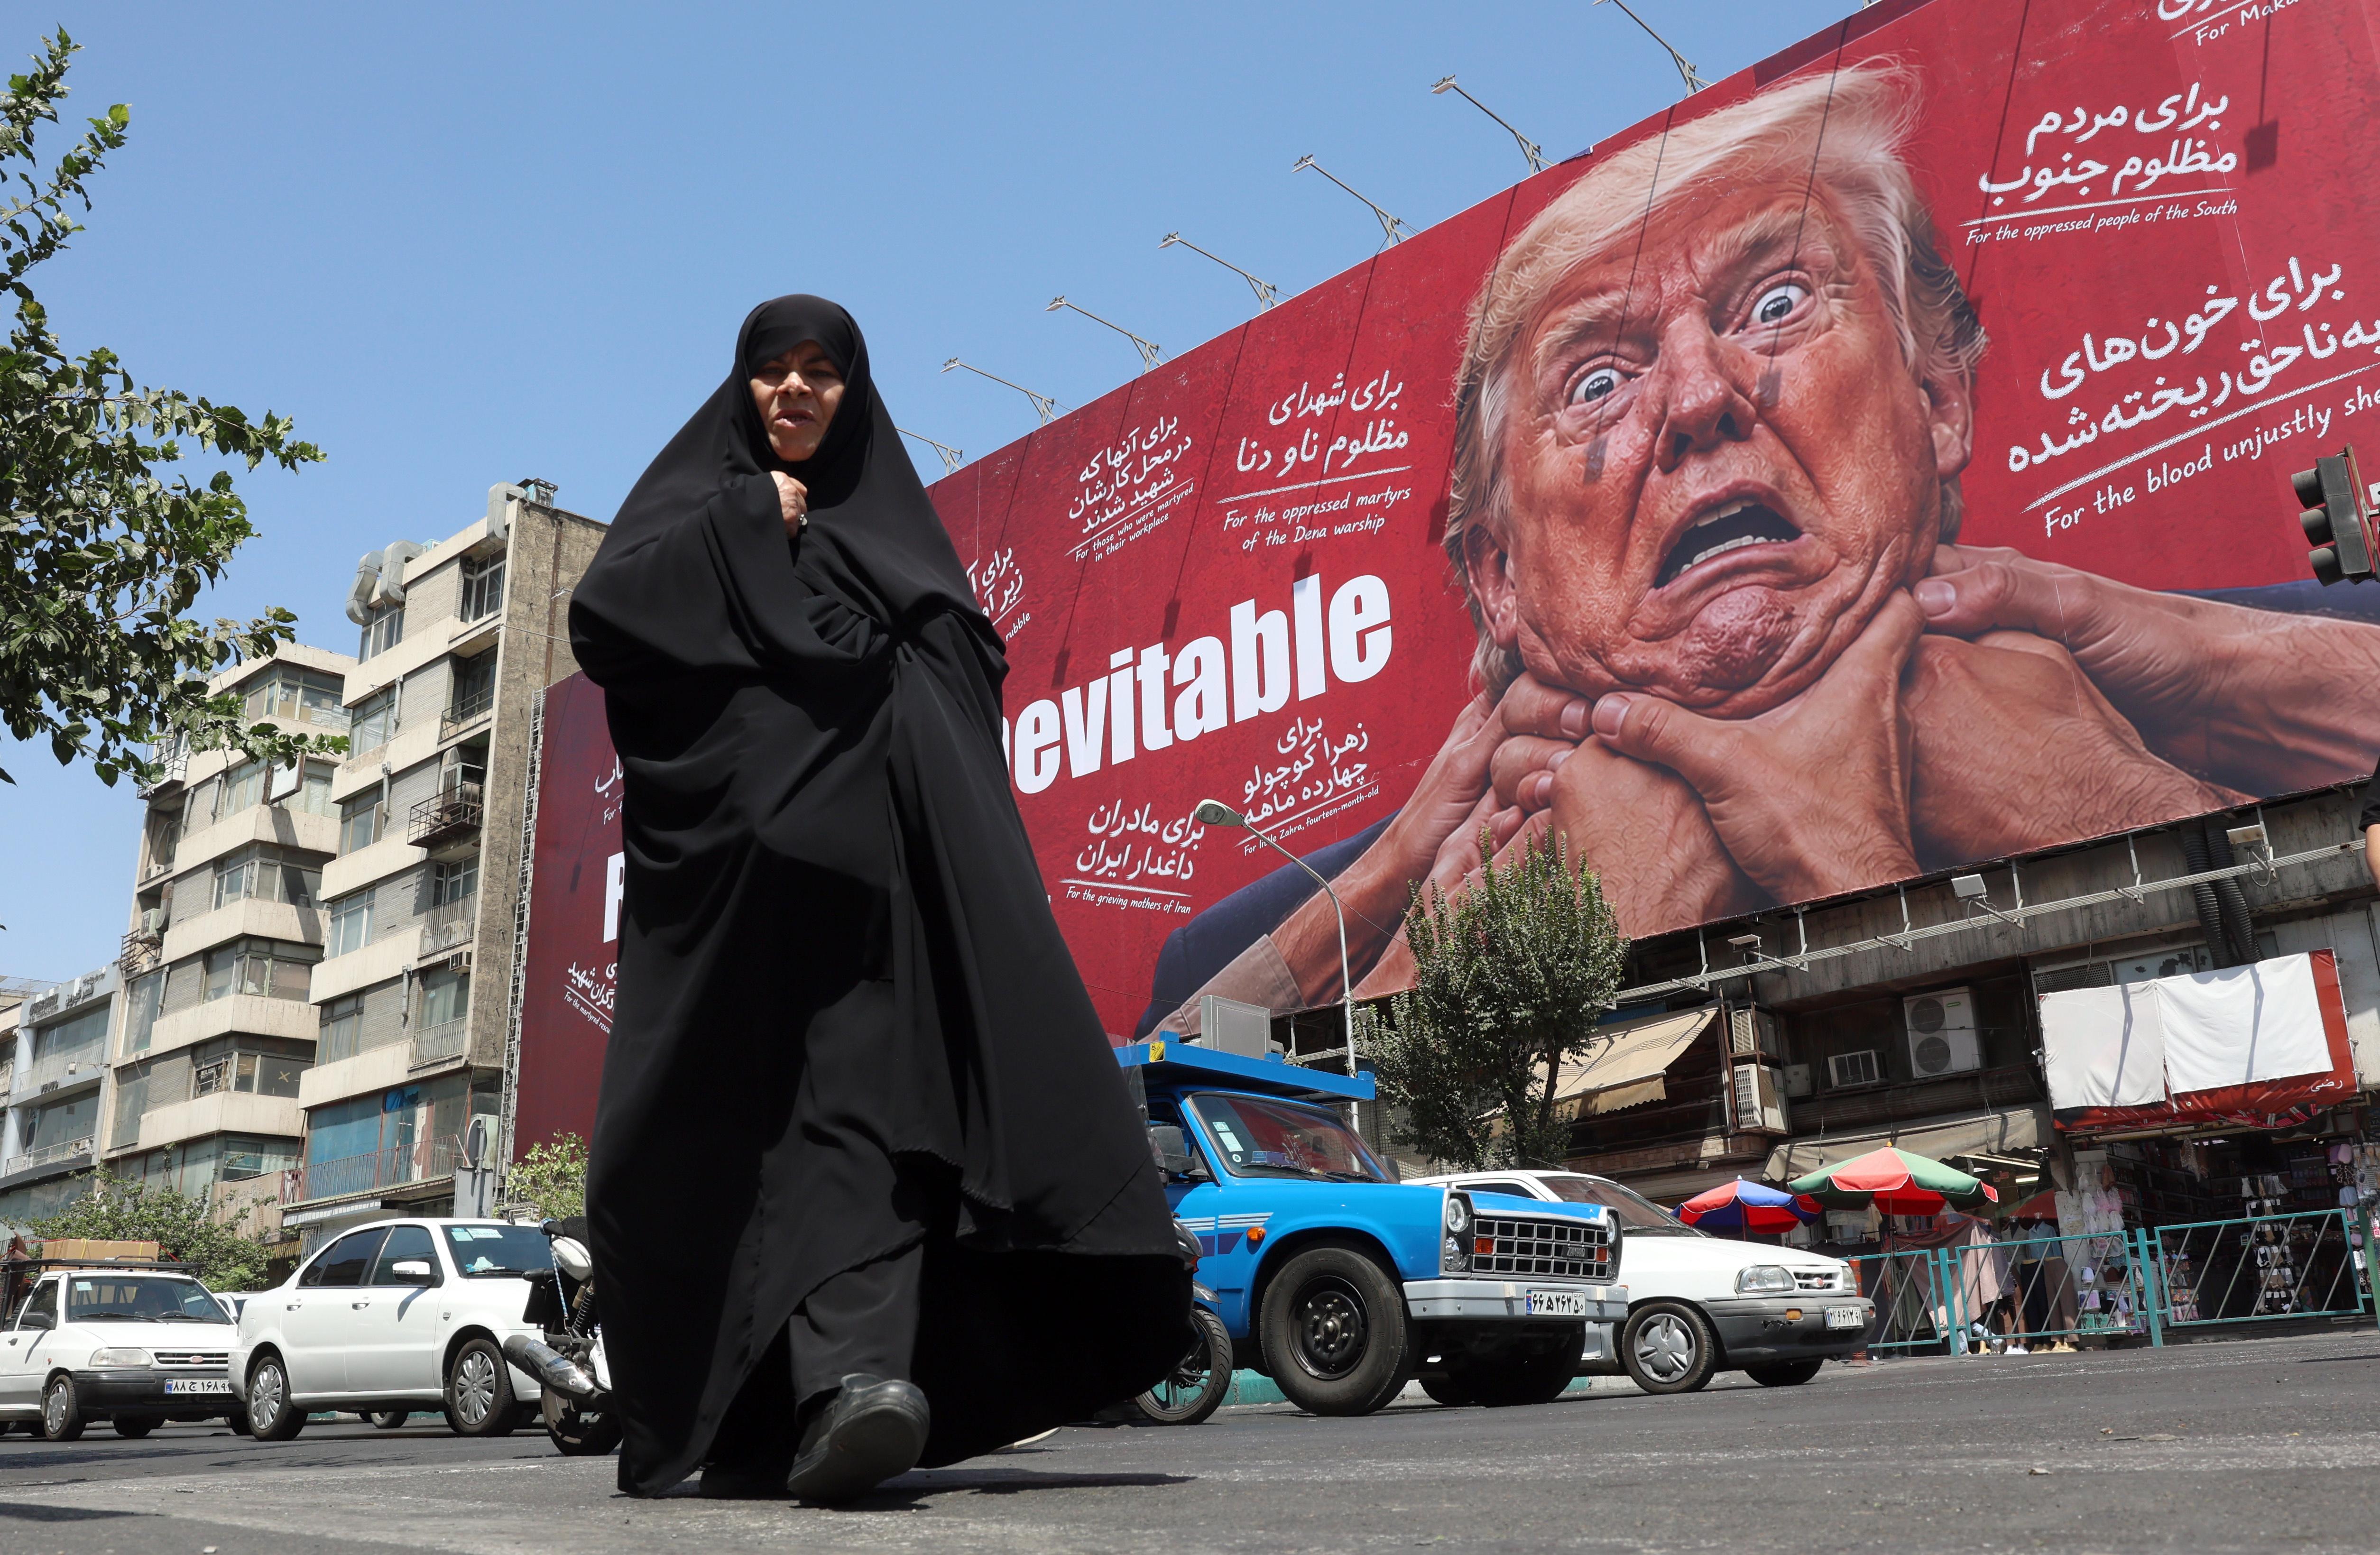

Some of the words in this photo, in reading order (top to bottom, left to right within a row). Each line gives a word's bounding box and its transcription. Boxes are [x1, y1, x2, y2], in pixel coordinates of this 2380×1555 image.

[2196, 23, 2229, 46] For
[2134, 81, 2229, 133] برای
[2026, 105, 2128, 157] مردم
[1978, 152, 2109, 207] جنوب
[2111, 138, 2238, 197] مظلوم
[1966, 230, 1991, 246] For
[1996, 224, 2019, 241] the
[2024, 212, 2094, 241] oppressed
[2095, 207, 2139, 233] people
[2145, 203, 2162, 223] of
[2165, 202, 2188, 220] the
[2193, 199, 2238, 217] South
[2248, 256, 2345, 322] برای
[1268, 372, 1347, 425] شهدای
[1351, 369, 1403, 412] برای
[2101, 370, 2232, 434] ریخته
[1107, 426, 1140, 468] آنها
[1142, 416, 1178, 450] برای
[1173, 436, 1192, 462] در
[1275, 427, 1319, 478] ناو
[1323, 418, 1409, 475] مظلوم
[2008, 407, 2099, 472] شده
[1079, 450, 1104, 482] که
[1134, 449, 1172, 484] محل
[1236, 437, 1272, 472] دنا
[2044, 506, 2085, 538] For
[2094, 484, 2136, 515] the
[2147, 444, 2213, 493] blood
[2223, 404, 2332, 460] unjustly
[2344, 385, 2380, 416] she
[1069, 460, 1134, 519] کارشان
[1130, 467, 1174, 506] شهید
[1075, 548, 1089, 562] For
[1092, 534, 1114, 551] those
[1117, 522, 1133, 536] who
[1135, 509, 1154, 525] were
[1157, 482, 1194, 513] martyred
[1082, 496, 1126, 534] شدند
[1223, 509, 1247, 531] For
[1255, 506, 1276, 524] the
[1282, 491, 1351, 525] oppressed
[1356, 486, 1412, 508] martyrs
[1095, 552, 1103, 562] in
[1106, 538, 1126, 556] their
[1129, 513, 1169, 542] workplace
[1242, 532, 1260, 552] of
[1265, 530, 1286, 547] the
[1293, 526, 1327, 543] Dena
[1334, 514, 1385, 535] warship
[982, 547, 1012, 587] برای
[999, 569, 1023, 613] زیر
[1005, 612, 1031, 642] rubble
[1277, 716, 1323, 754] برای
[1323, 722, 1369, 767] زهرا
[1242, 742, 1317, 804] کوچولو
[1301, 762, 1368, 801] چهارده
[603, 807, 616, 825] For
[1088, 798, 1160, 837] مادران
[1244, 792, 1296, 824] ماهه
[1244, 844, 1256, 856] For
[1279, 824, 1305, 839] Zahra,
[1306, 785, 1380, 827] fourteen-month-old
[1162, 810, 1205, 850] برای
[1076, 839, 1132, 878] ایران
[1125, 846, 1194, 881] داغدار
[1066, 885, 1080, 899] For
[1082, 889, 1095, 901] the
[1096, 893, 1129, 910] grieving
[1130, 898, 1162, 911] mothers
[1163, 900, 1174, 914] of
[1174, 901, 1191, 914] Iran
[568, 961, 596, 989] شهید
[564, 991, 572, 1003] For
[580, 1006, 600, 1025] martyred
[599, 1021, 610, 1035] rescu
[590, 984, 615, 1012] دگران
[2311, 1079, 2343, 1092] رضی
[1533, 1293, 1544, 1312] ۶۶
[1555, 1294, 1572, 1313] ۳۶۳
[173, 1381, 186, 1392] ۸۸
[189, 1381, 197, 1392] ج
[201, 1380, 218, 1392] ۱۶۸
